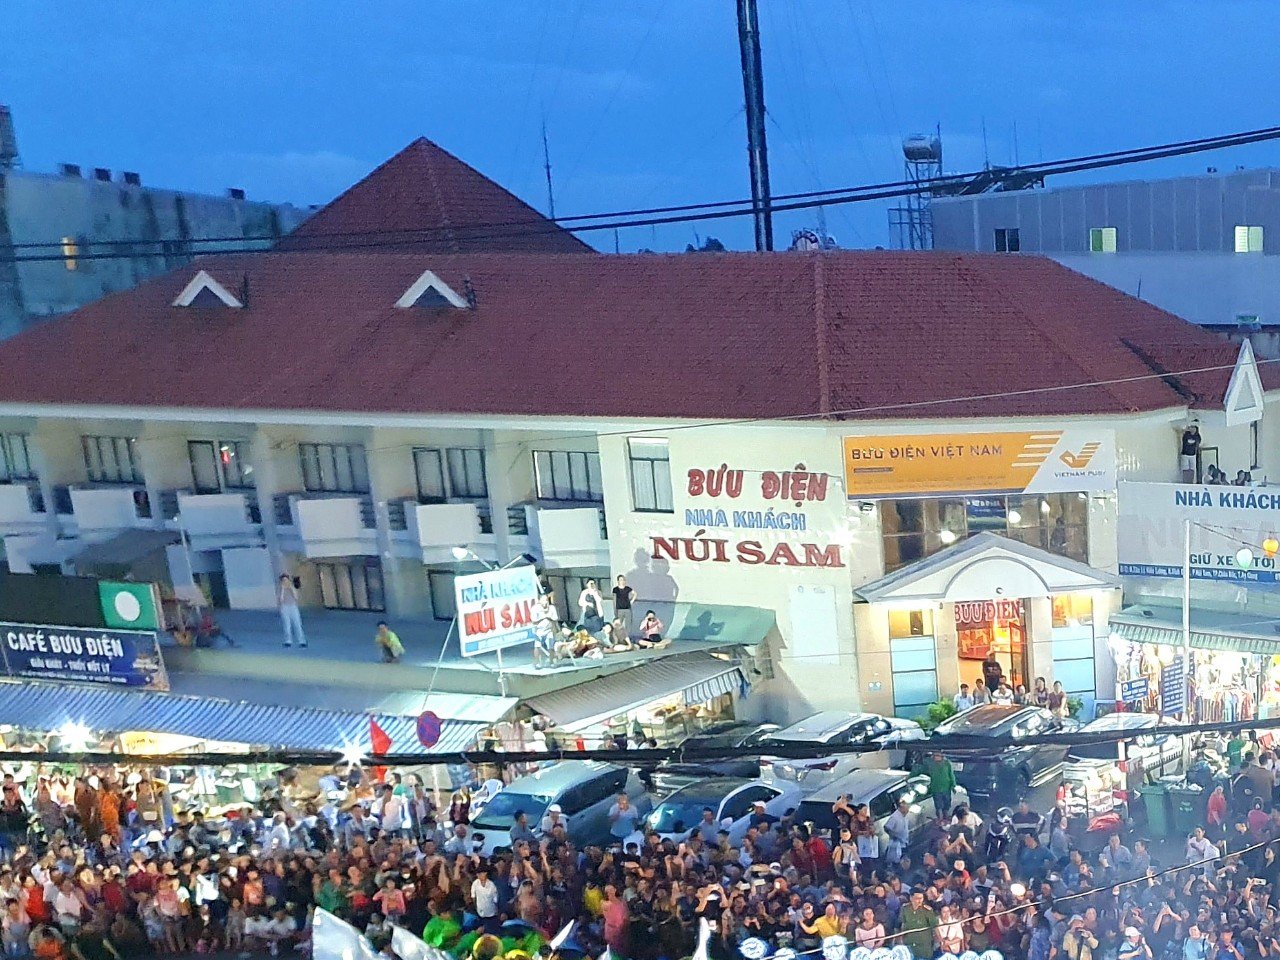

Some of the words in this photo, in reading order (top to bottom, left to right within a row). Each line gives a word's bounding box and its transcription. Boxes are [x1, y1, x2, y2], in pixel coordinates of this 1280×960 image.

[889, 443, 926, 461] ĐIỆN
[930, 443, 965, 459] VIỆT
[969, 444, 1003, 456] NAM
[687, 463, 744, 498] BƯU
[761, 463, 829, 508] ĐIỆN
[1175, 488, 1213, 507] NHÀ
[732, 507, 807, 531] KHÁCH
[649, 529, 730, 562] NÚI
[735, 540, 846, 568] SAM
[1216, 555, 1233, 566] XE
[7, 630, 47, 653] CAFÉ
[48, 633, 83, 655] BƯU
[85, 633, 124, 660] ĐIỆN
